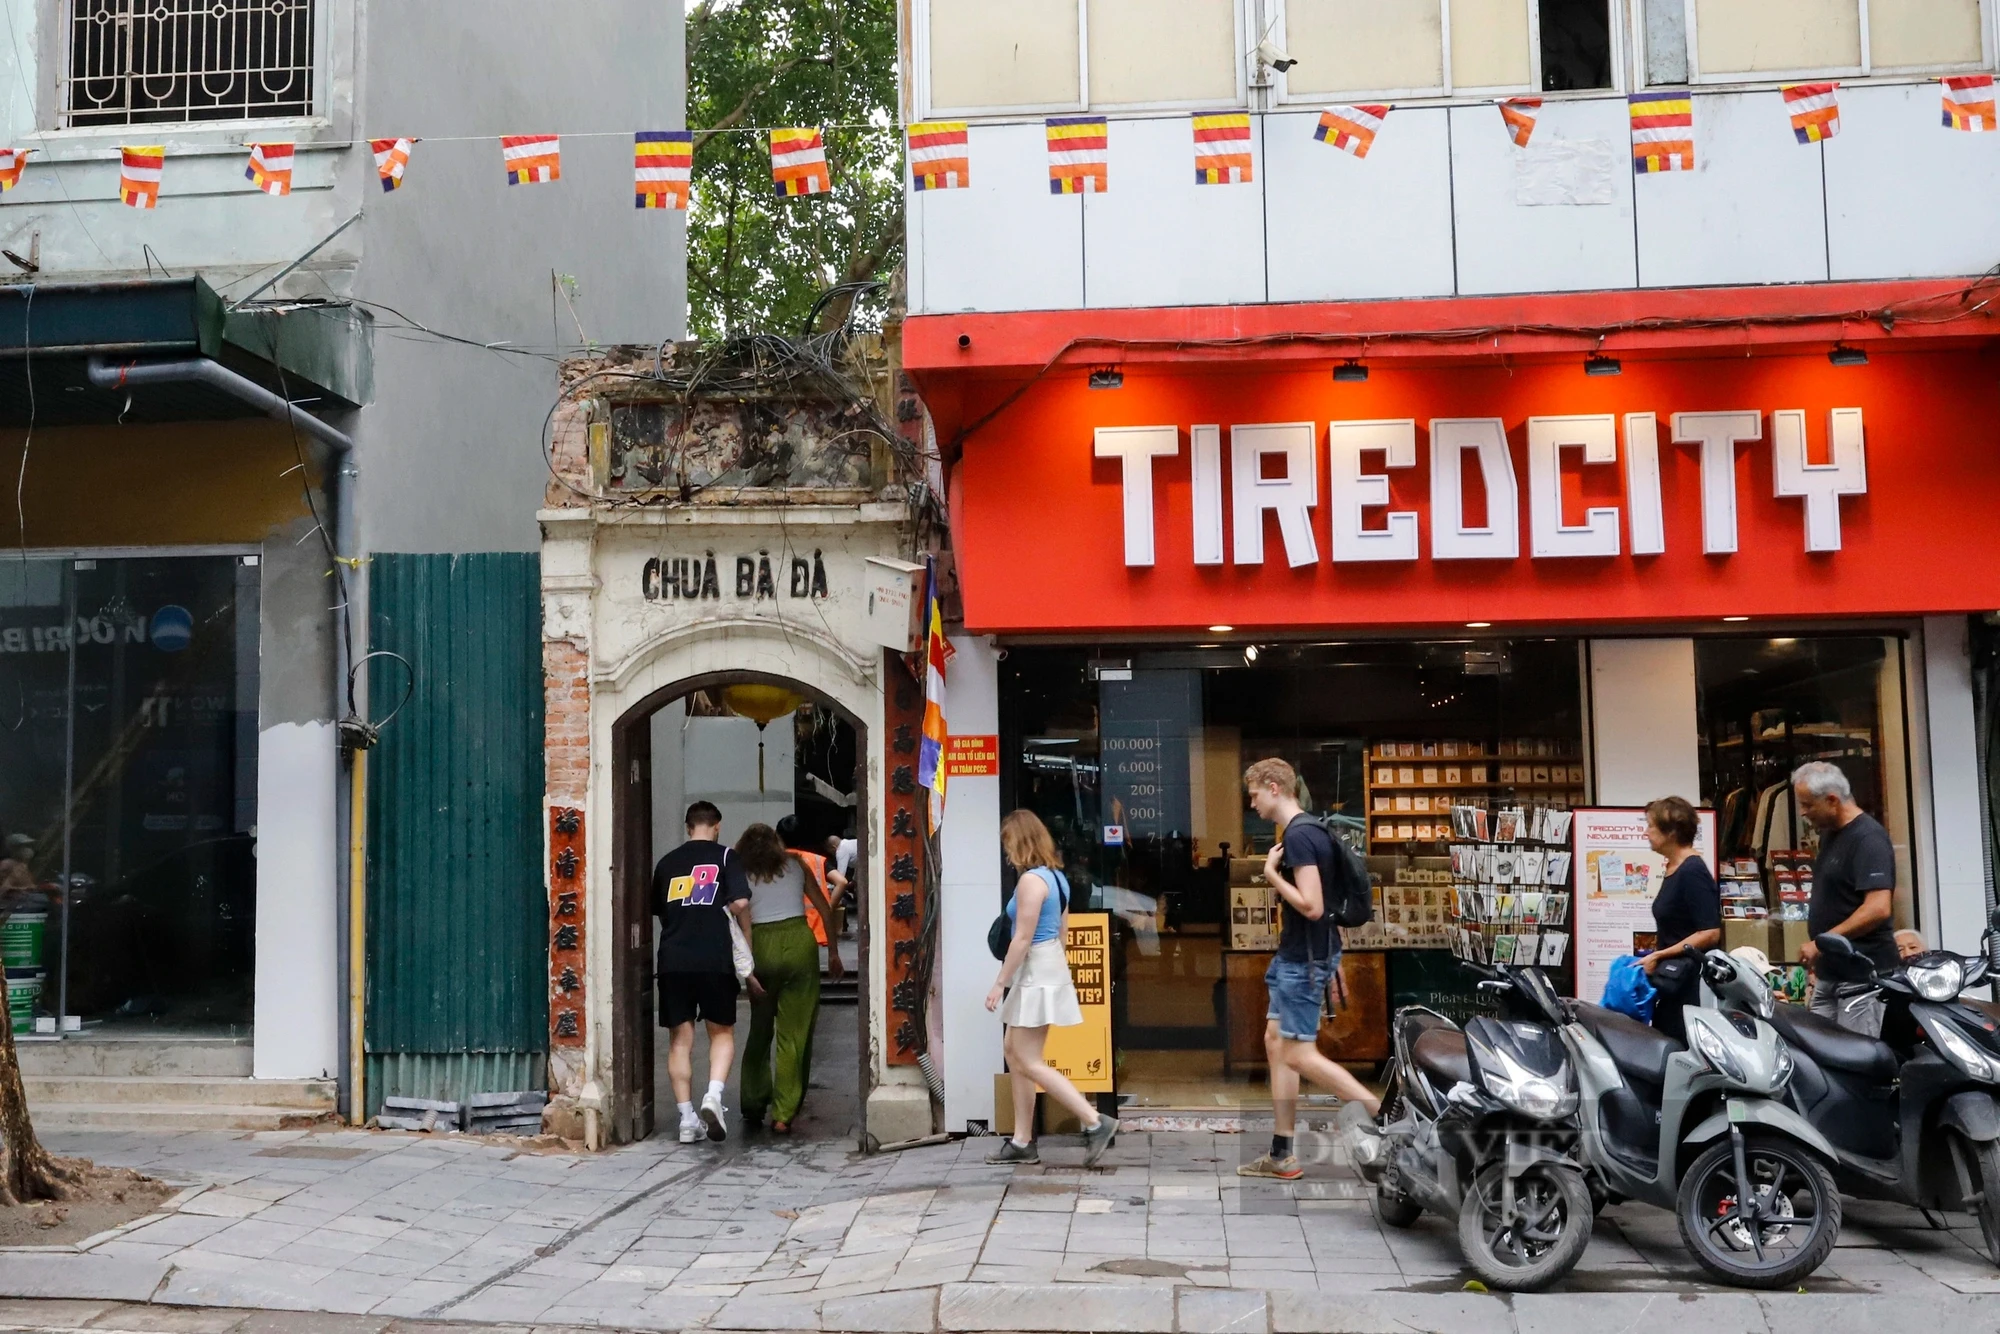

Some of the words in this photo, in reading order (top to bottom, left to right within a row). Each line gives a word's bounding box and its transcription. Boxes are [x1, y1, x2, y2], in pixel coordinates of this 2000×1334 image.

[1094, 407, 1867, 568] TIREDCITY
[951, 765, 958, 773] AN
[973, 765, 987, 774] PCCC
[1077, 931, 1101, 945] FOR
[1066, 950, 1102, 966] NIQUE
[1077, 969, 1101, 983] ART
[1075, 988, 1102, 1002] TS?
